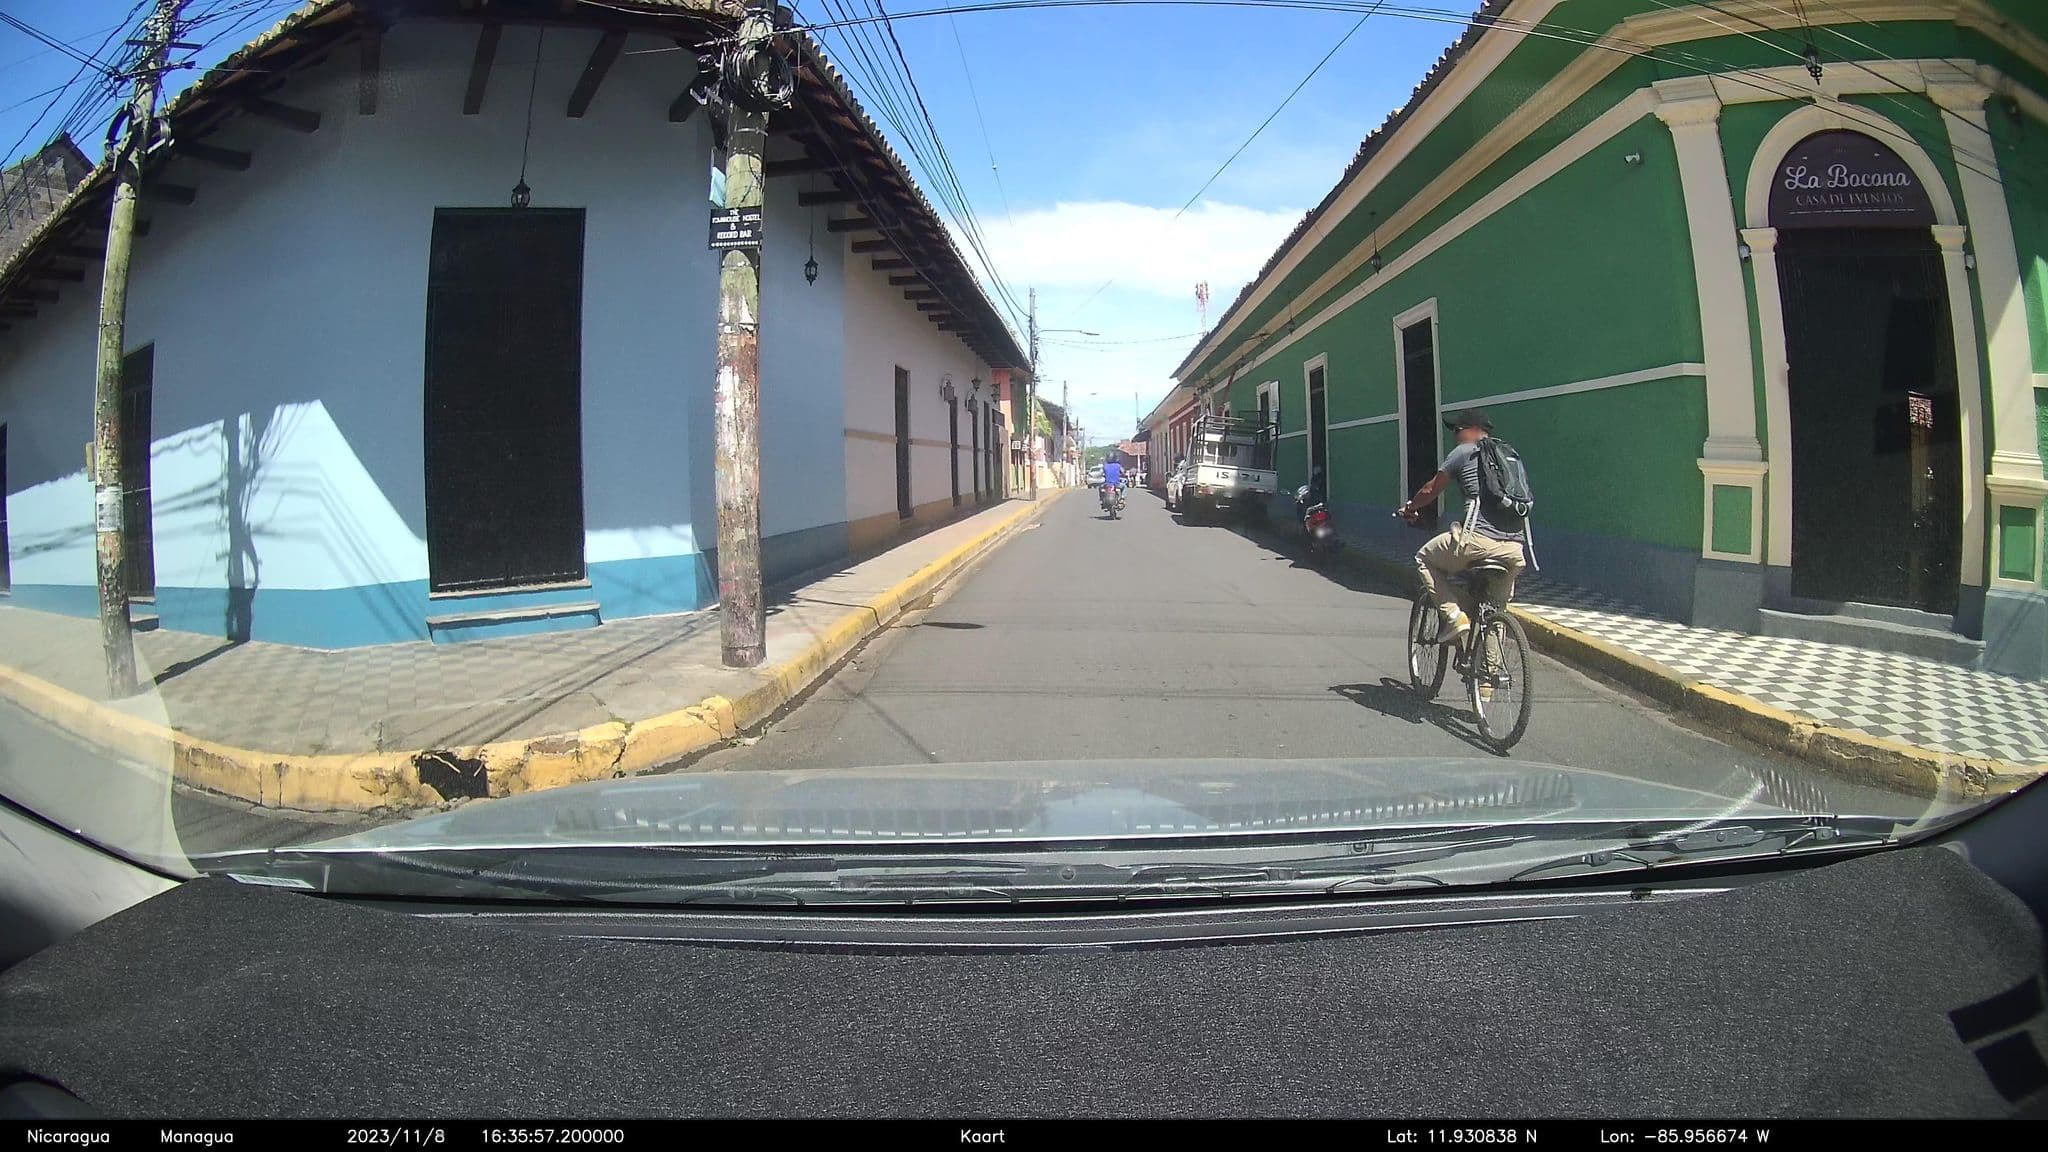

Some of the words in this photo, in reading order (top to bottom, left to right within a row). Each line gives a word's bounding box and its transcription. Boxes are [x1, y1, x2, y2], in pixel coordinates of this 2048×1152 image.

[1784, 165, 1821, 190] La
[1827, 163, 1911, 188] Bocona
[1796, 194, 1827, 206] CASA
[1829, 193, 1847, 205] DE
[1849, 192, 1904, 204] EVENTOS
[740, 230, 752, 238] BAR
